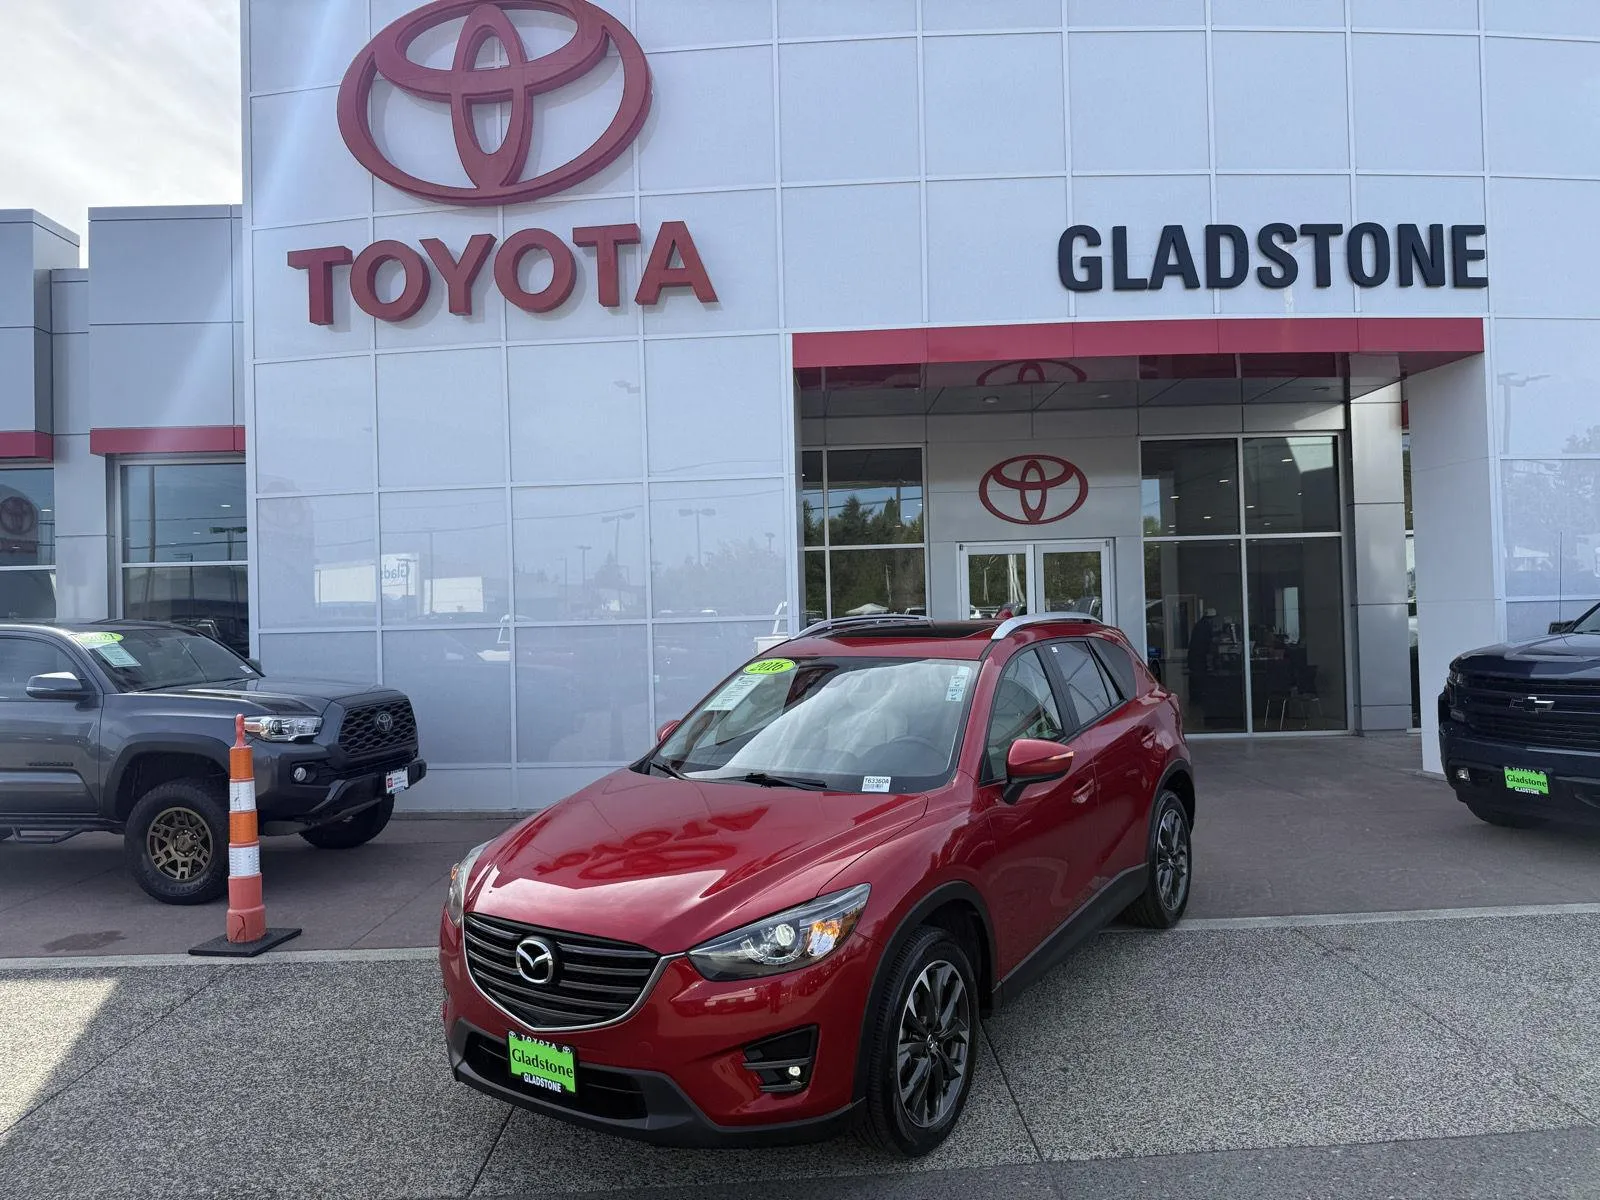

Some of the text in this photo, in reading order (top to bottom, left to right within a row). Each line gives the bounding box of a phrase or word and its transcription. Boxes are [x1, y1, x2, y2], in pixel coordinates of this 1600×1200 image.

[1058, 222, 1488, 291] GLADSTONE
[287, 220, 719, 326] TOYOTA
[1507, 774, 1546, 787] Gladstone
[521, 1034, 557, 1049] TOYOTA
[512, 1049, 573, 1078] Gladstone
[524, 1073, 561, 1092] GLADSTONE
